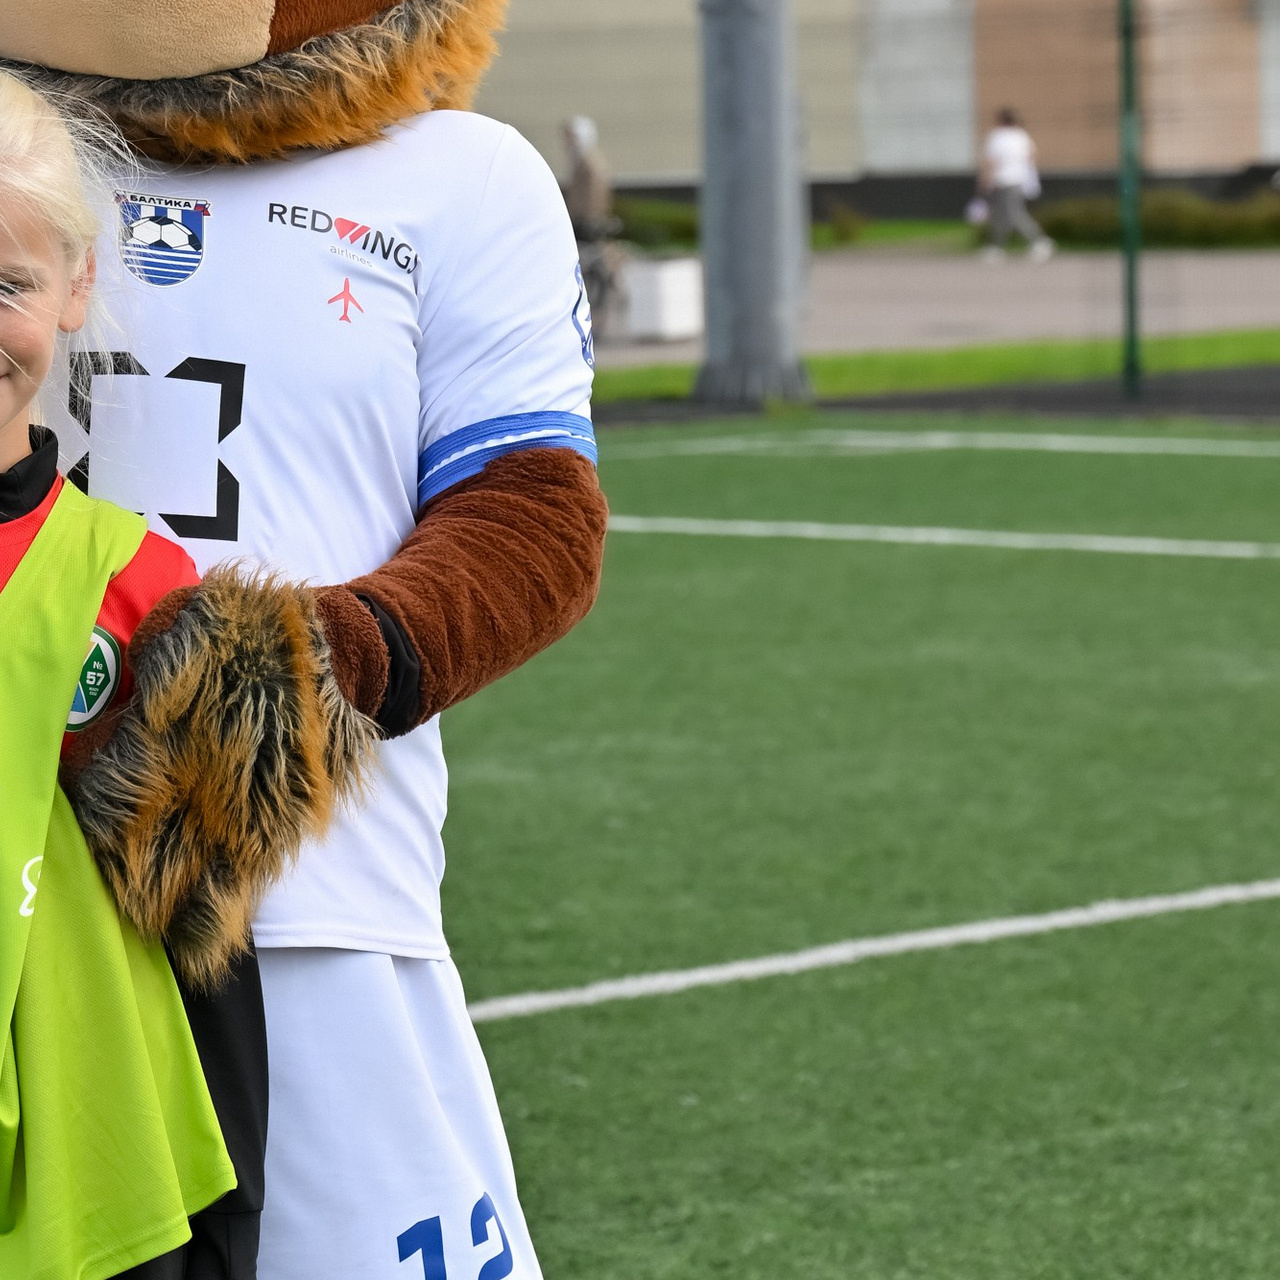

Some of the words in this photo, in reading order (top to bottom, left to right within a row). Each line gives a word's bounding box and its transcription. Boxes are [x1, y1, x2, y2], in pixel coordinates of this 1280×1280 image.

[129, 194, 192, 209] БАЛТИКА
[330, 245, 373, 268] airlines
[86, 671, 106, 686] 57
